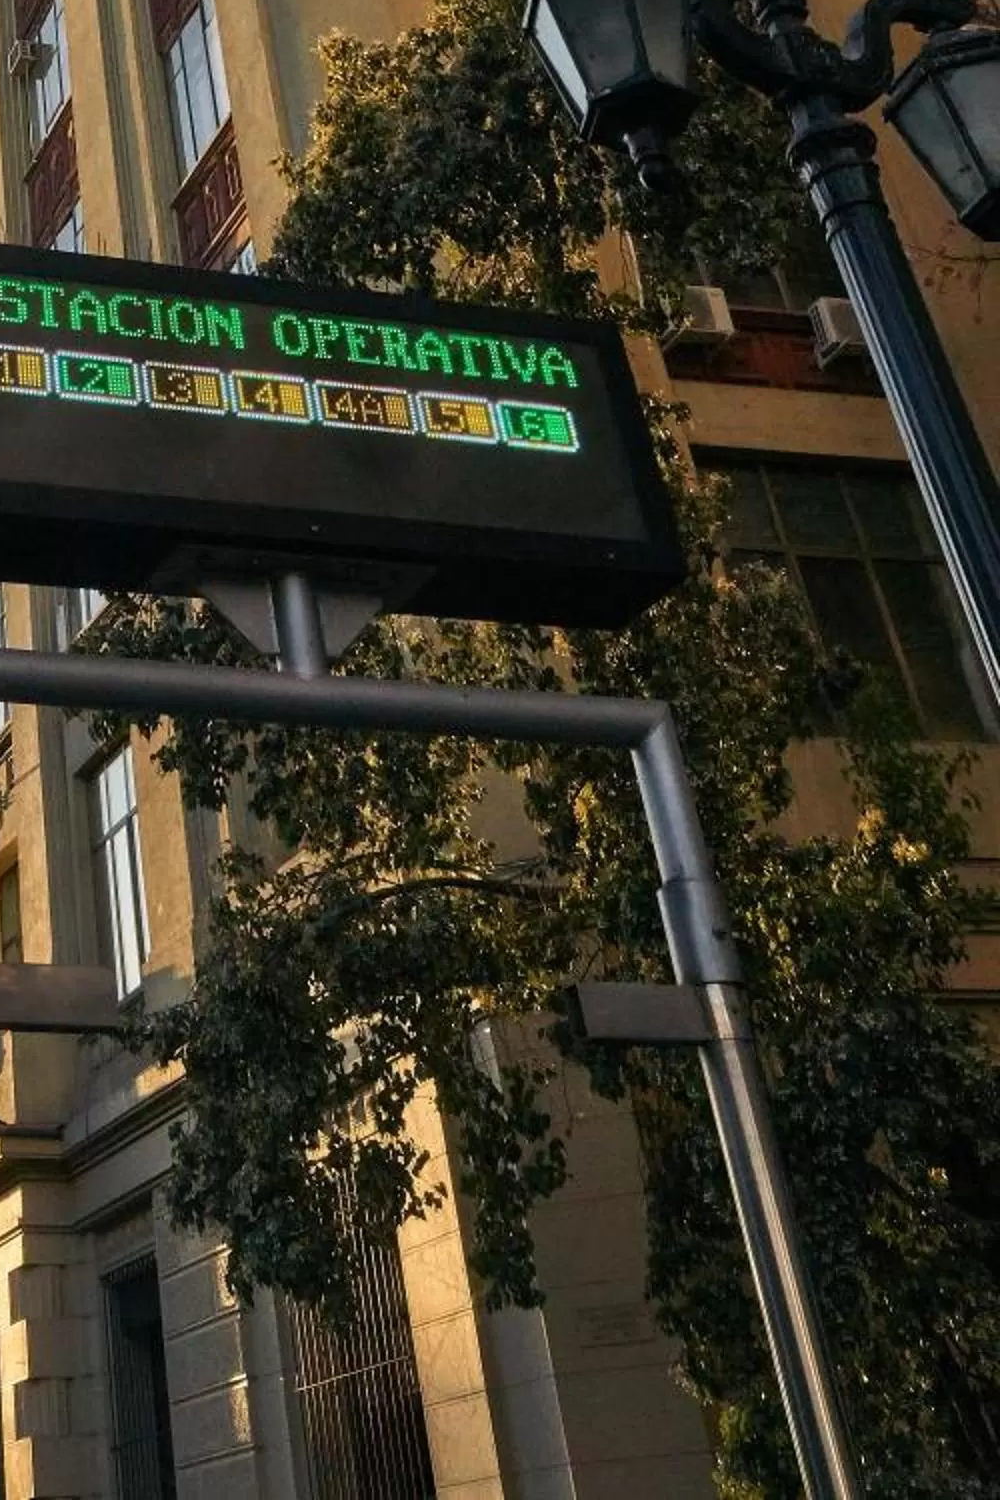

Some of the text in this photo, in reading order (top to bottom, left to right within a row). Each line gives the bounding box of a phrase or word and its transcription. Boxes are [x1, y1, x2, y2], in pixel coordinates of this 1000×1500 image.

[273, 313, 578, 388] OPERATIVA
[61, 359, 103, 393] L2
[151, 369, 193, 403] L3
[236, 379, 279, 414] L4
[321, 387, 385, 425] L4A
[425, 401, 465, 433] L5
[503, 408, 546, 440] L6
